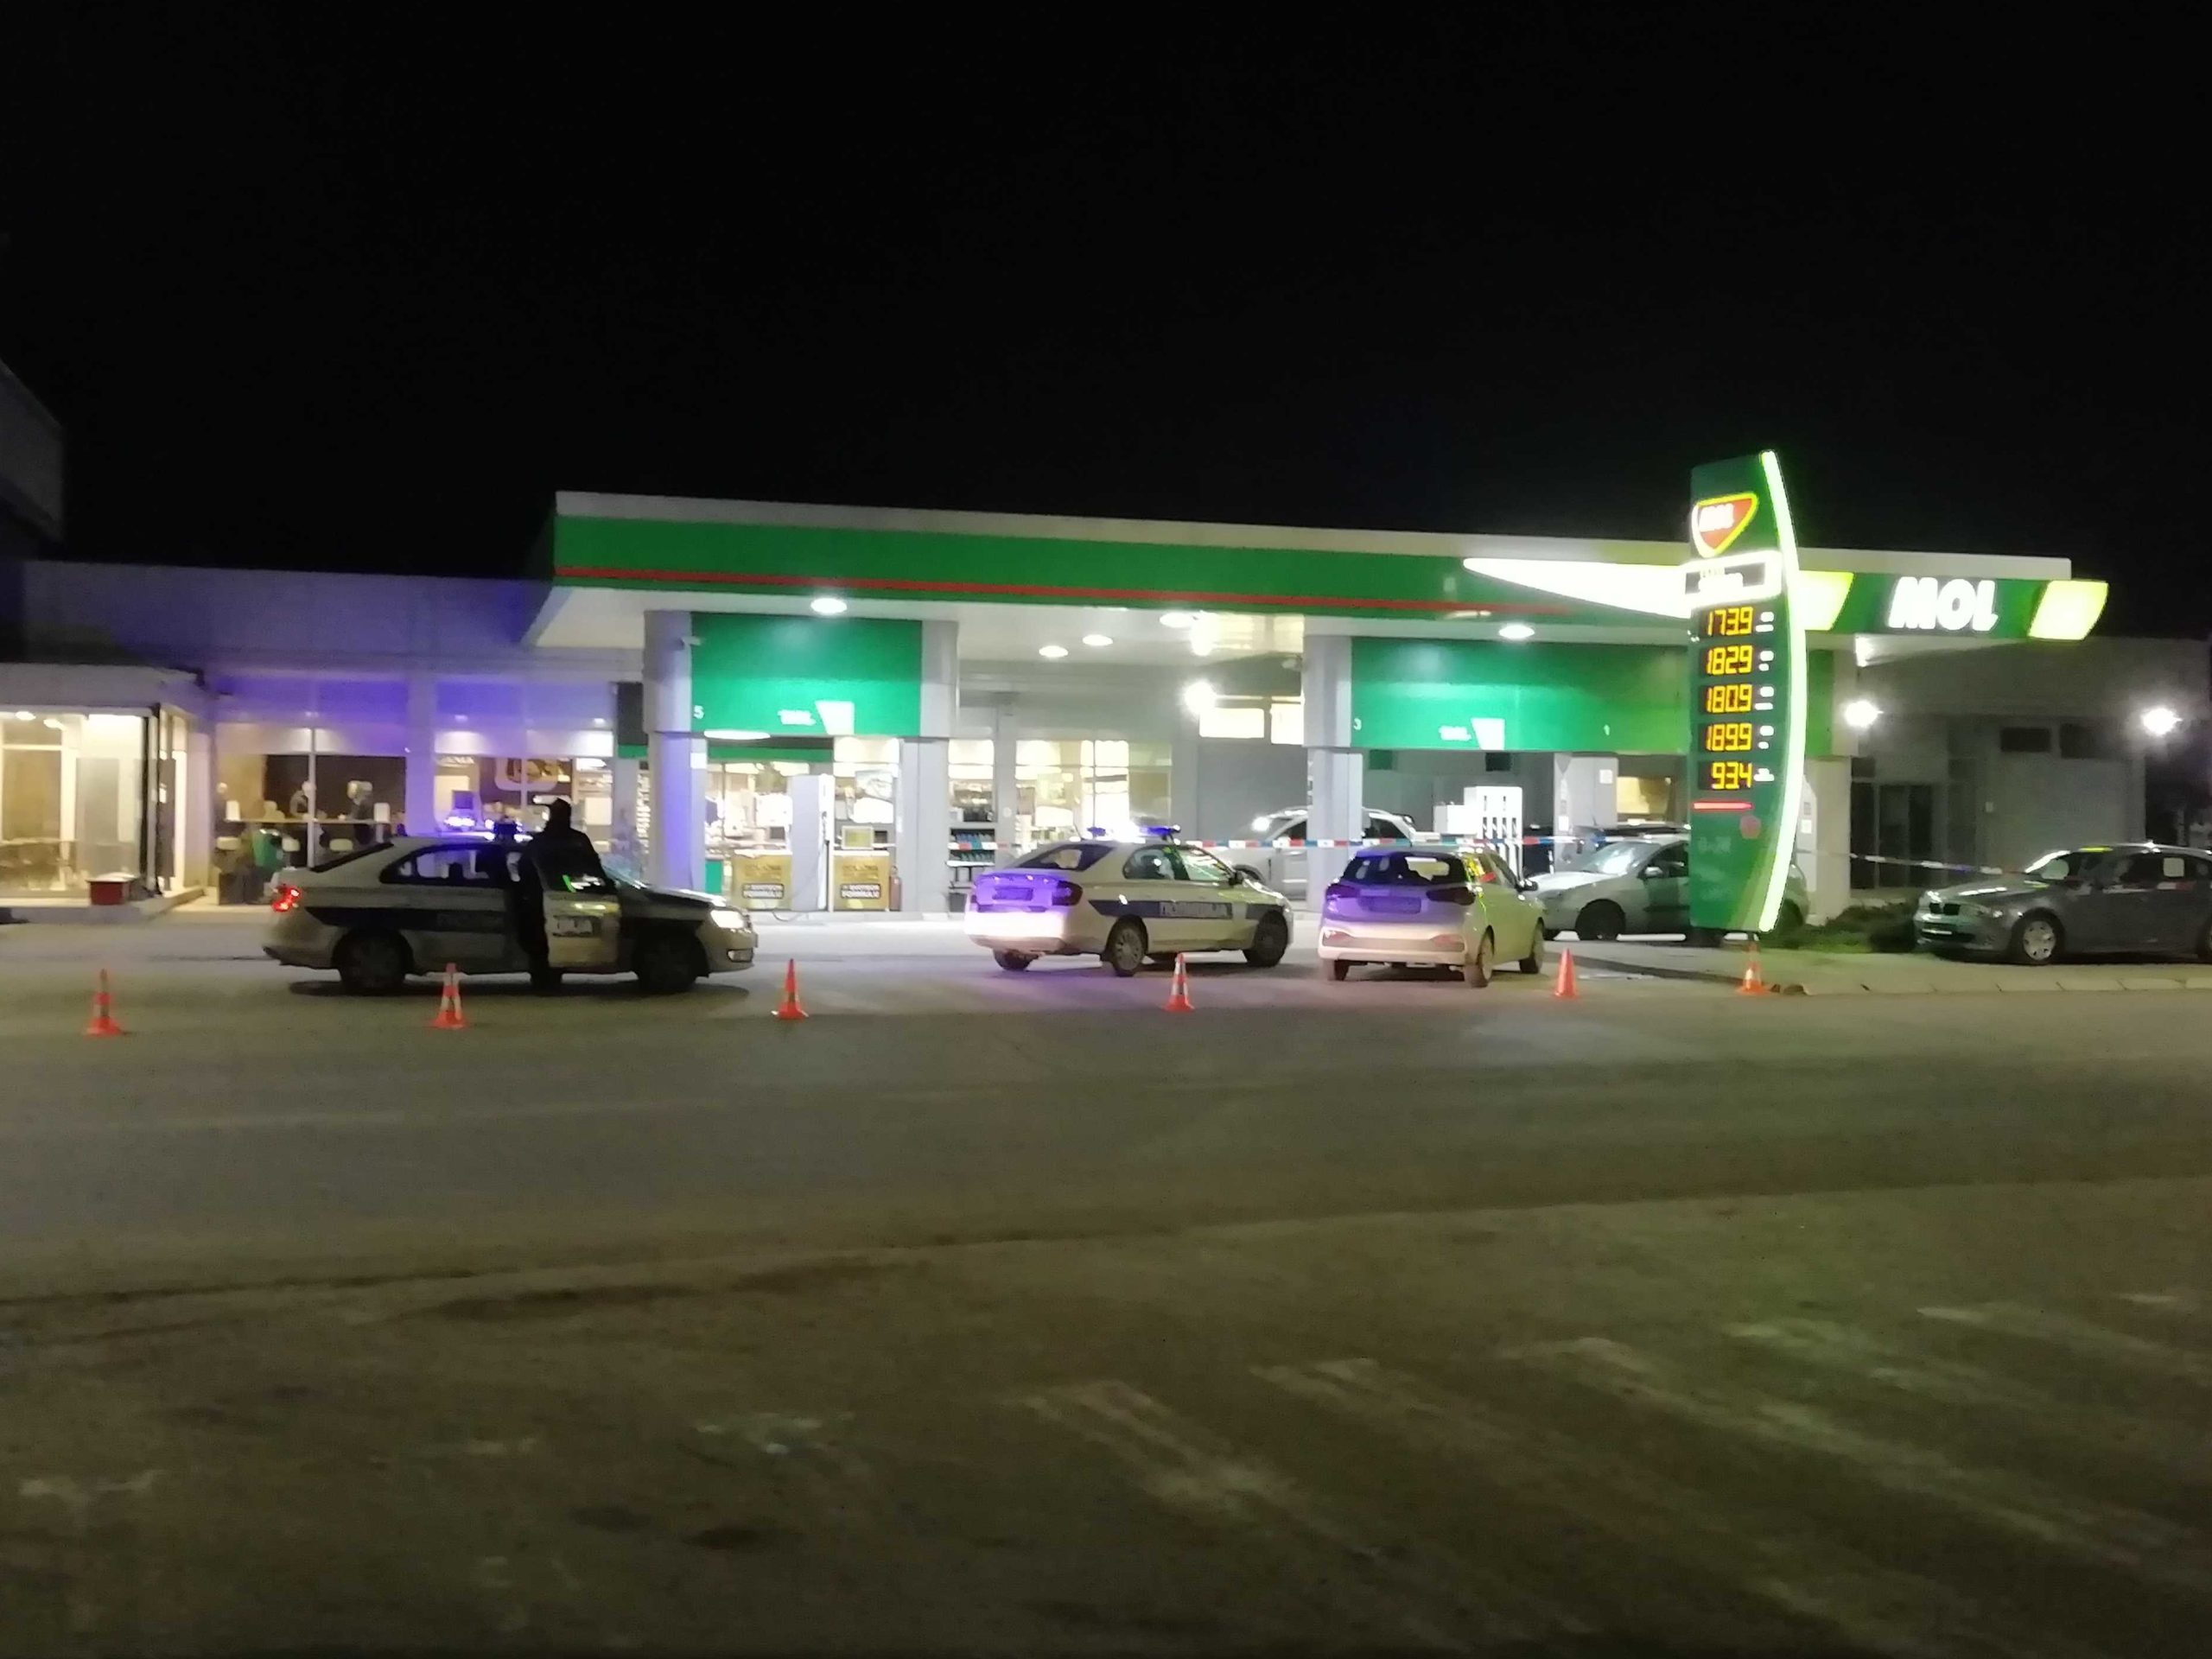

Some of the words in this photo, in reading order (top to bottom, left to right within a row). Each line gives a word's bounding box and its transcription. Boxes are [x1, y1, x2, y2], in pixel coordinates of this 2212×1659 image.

[1888, 576, 1999, 632] MOL
[693, 704, 705, 720] 5
[1353, 717, 1363, 731] 3
